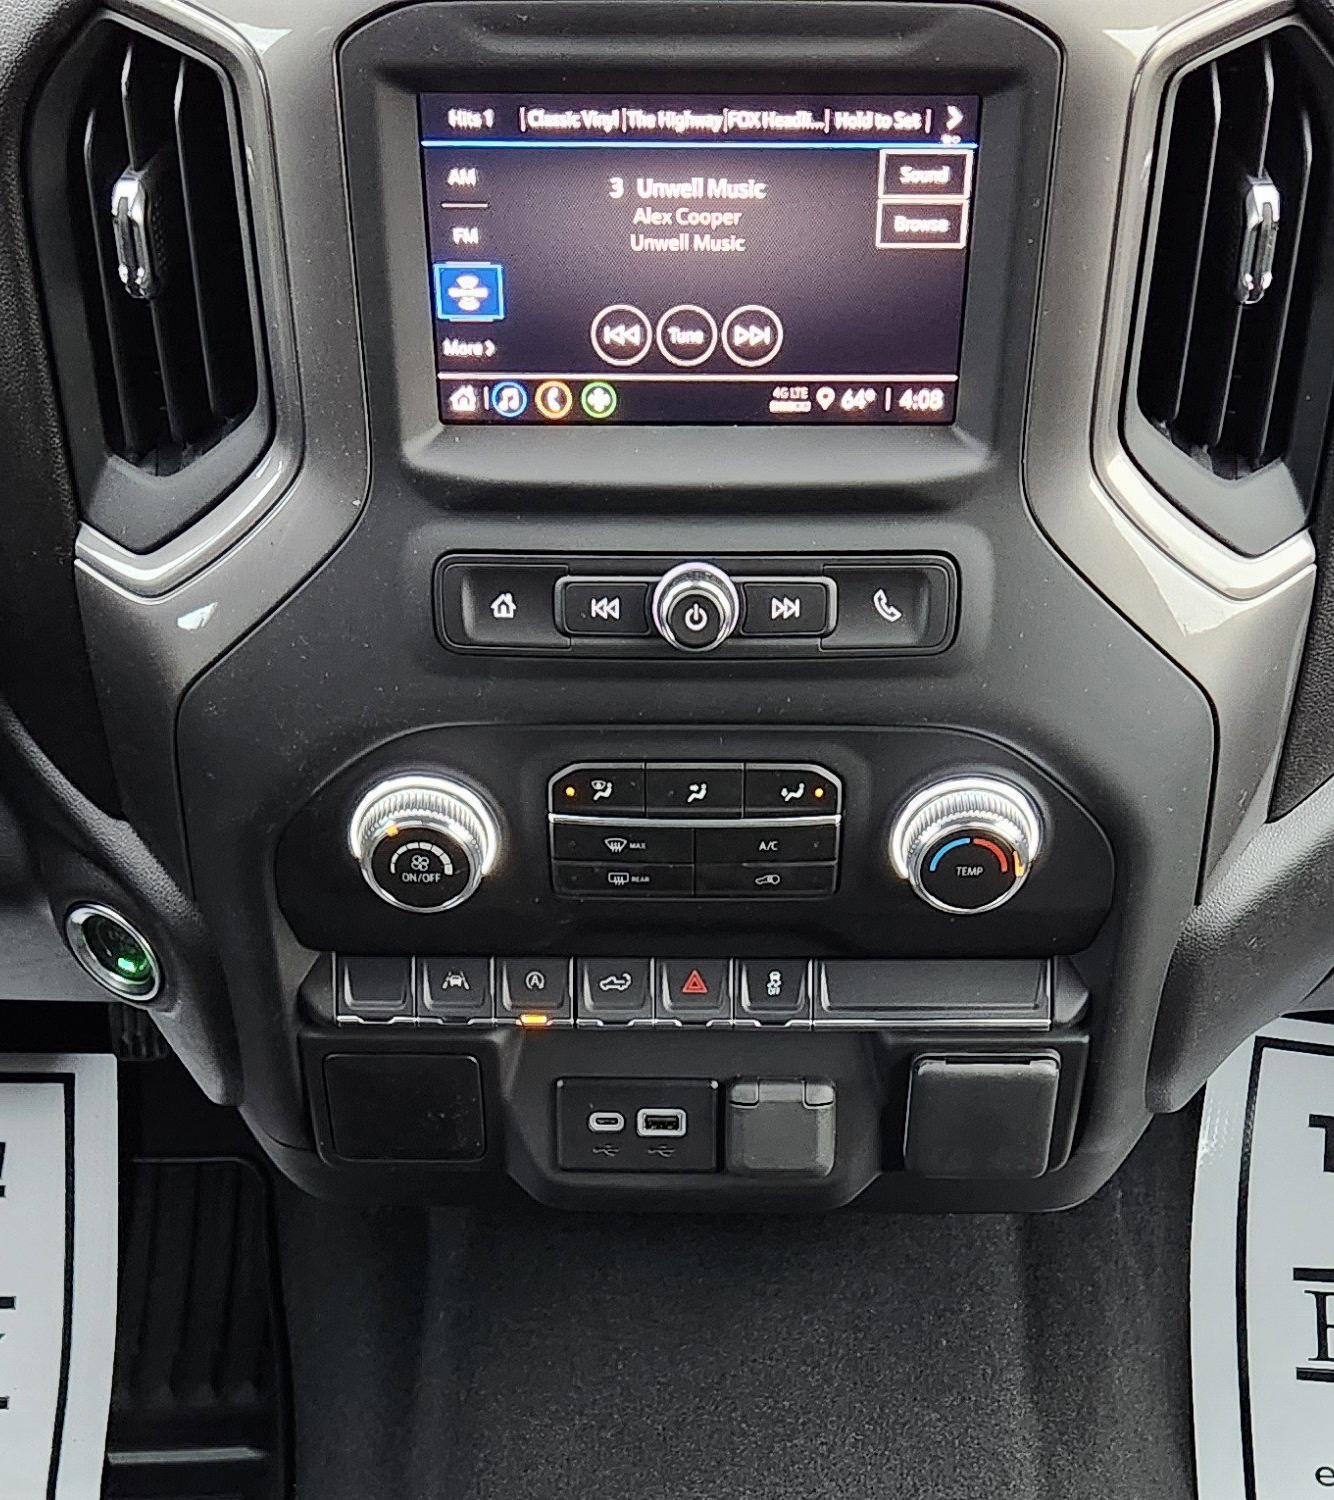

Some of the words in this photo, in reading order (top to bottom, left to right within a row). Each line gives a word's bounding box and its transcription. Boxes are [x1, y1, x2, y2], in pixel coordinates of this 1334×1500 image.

[448, 109, 482, 128] Hits
[527, 108, 581, 129] Classic
[582, 109, 619, 133] Vinyl
[627, 109, 656, 129] The
[657, 109, 724, 133] Highway
[728, 110, 761, 130] FOX
[835, 111, 874, 131] Hold
[875, 112, 893, 131] to
[893, 111, 922, 131] Set
[447, 167, 477, 187] AM
[899, 165, 951, 184] Sound
[609, 177, 624, 199] 3
[636, 177, 704, 199] Unwell
[706, 178, 767, 200] Music
[632, 207, 673, 226] Alex
[675, 207, 743, 231] Cooper
[893, 215, 951, 233] Browse
[452, 226, 480, 245] FM
[629, 233, 689, 251] Unwell
[693, 233, 747, 252] Music
[667, 325, 704, 344] Tune
[442, 338, 484, 357] More
[772, 386, 789, 399] 4G
[789, 386, 809, 400] LTE
[898, 387, 945, 412] 4:08
[758, 841, 778, 851] A/C
[401, 872, 442, 883] ON/OFF
[955, 866, 984, 877] TEMP
